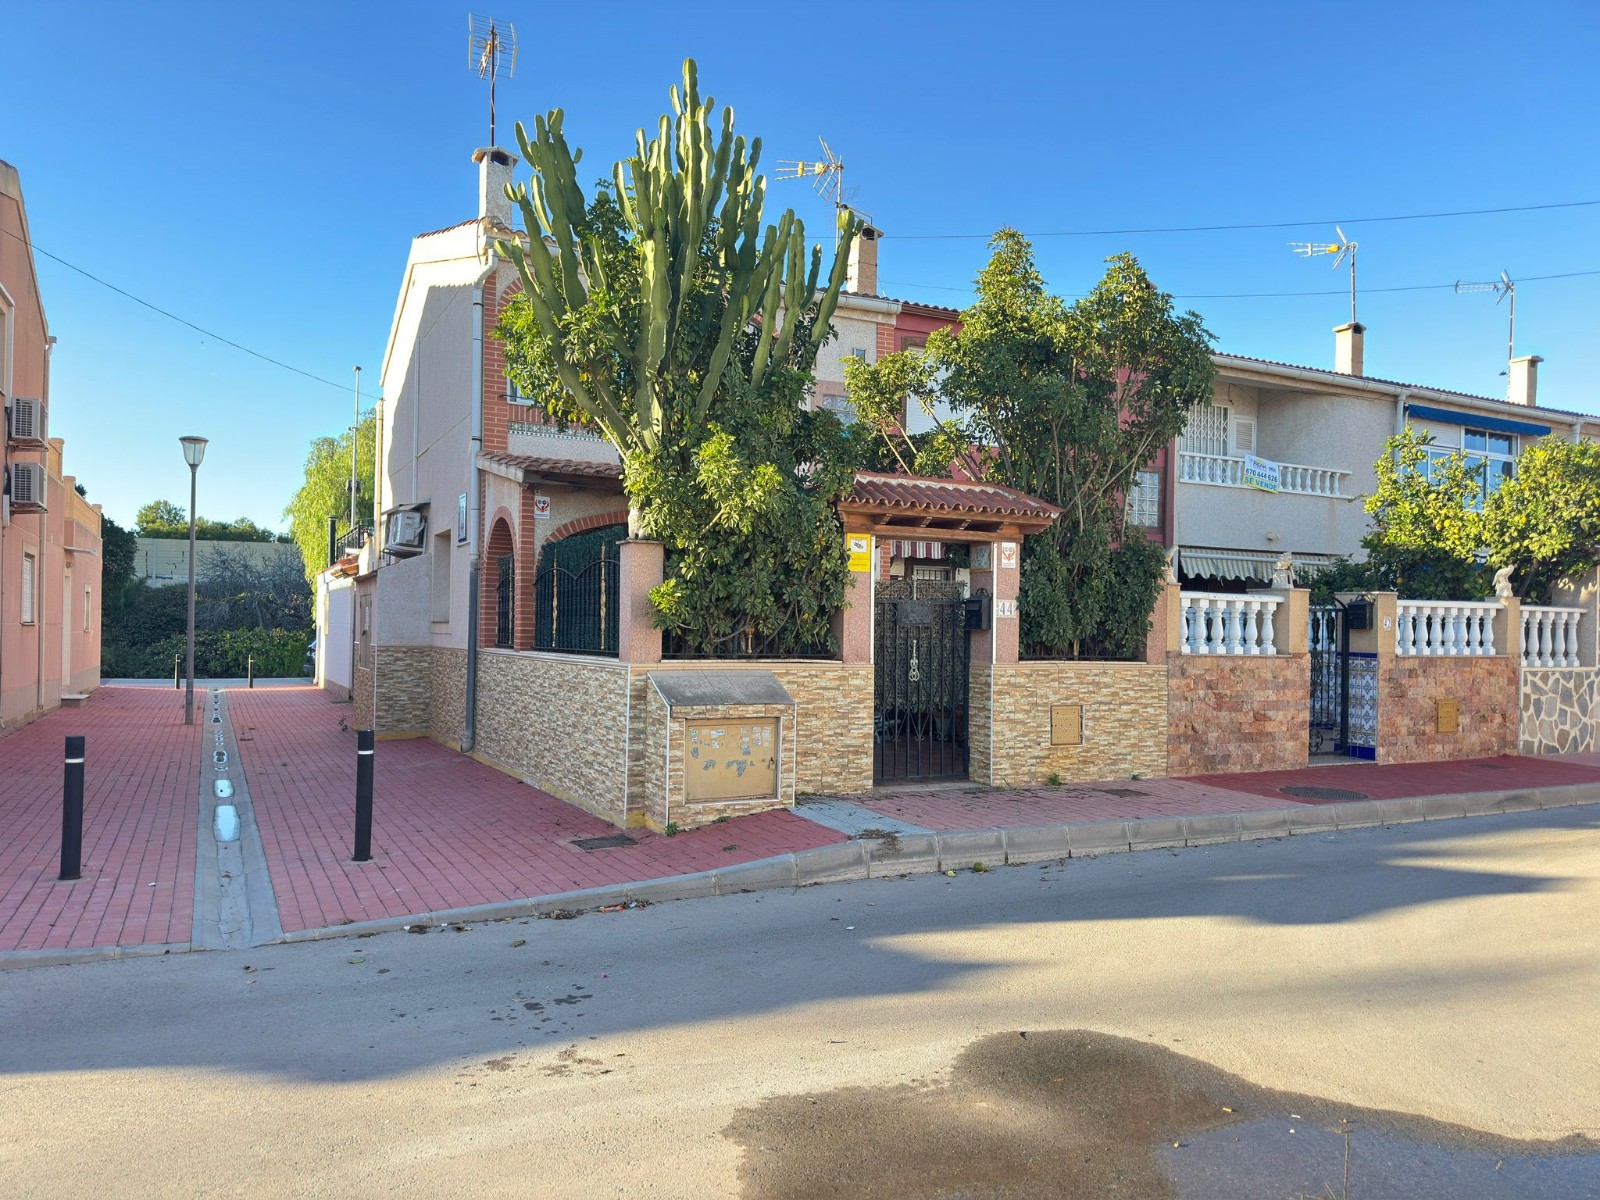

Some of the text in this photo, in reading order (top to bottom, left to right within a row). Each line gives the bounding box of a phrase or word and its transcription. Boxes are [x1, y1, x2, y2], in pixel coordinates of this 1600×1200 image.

[1245, 468, 1256, 476] 670
[1257, 471, 1267, 479] 444
[1255, 479, 1278, 490] VENDE
[1000, 602, 1012, 615] 44
